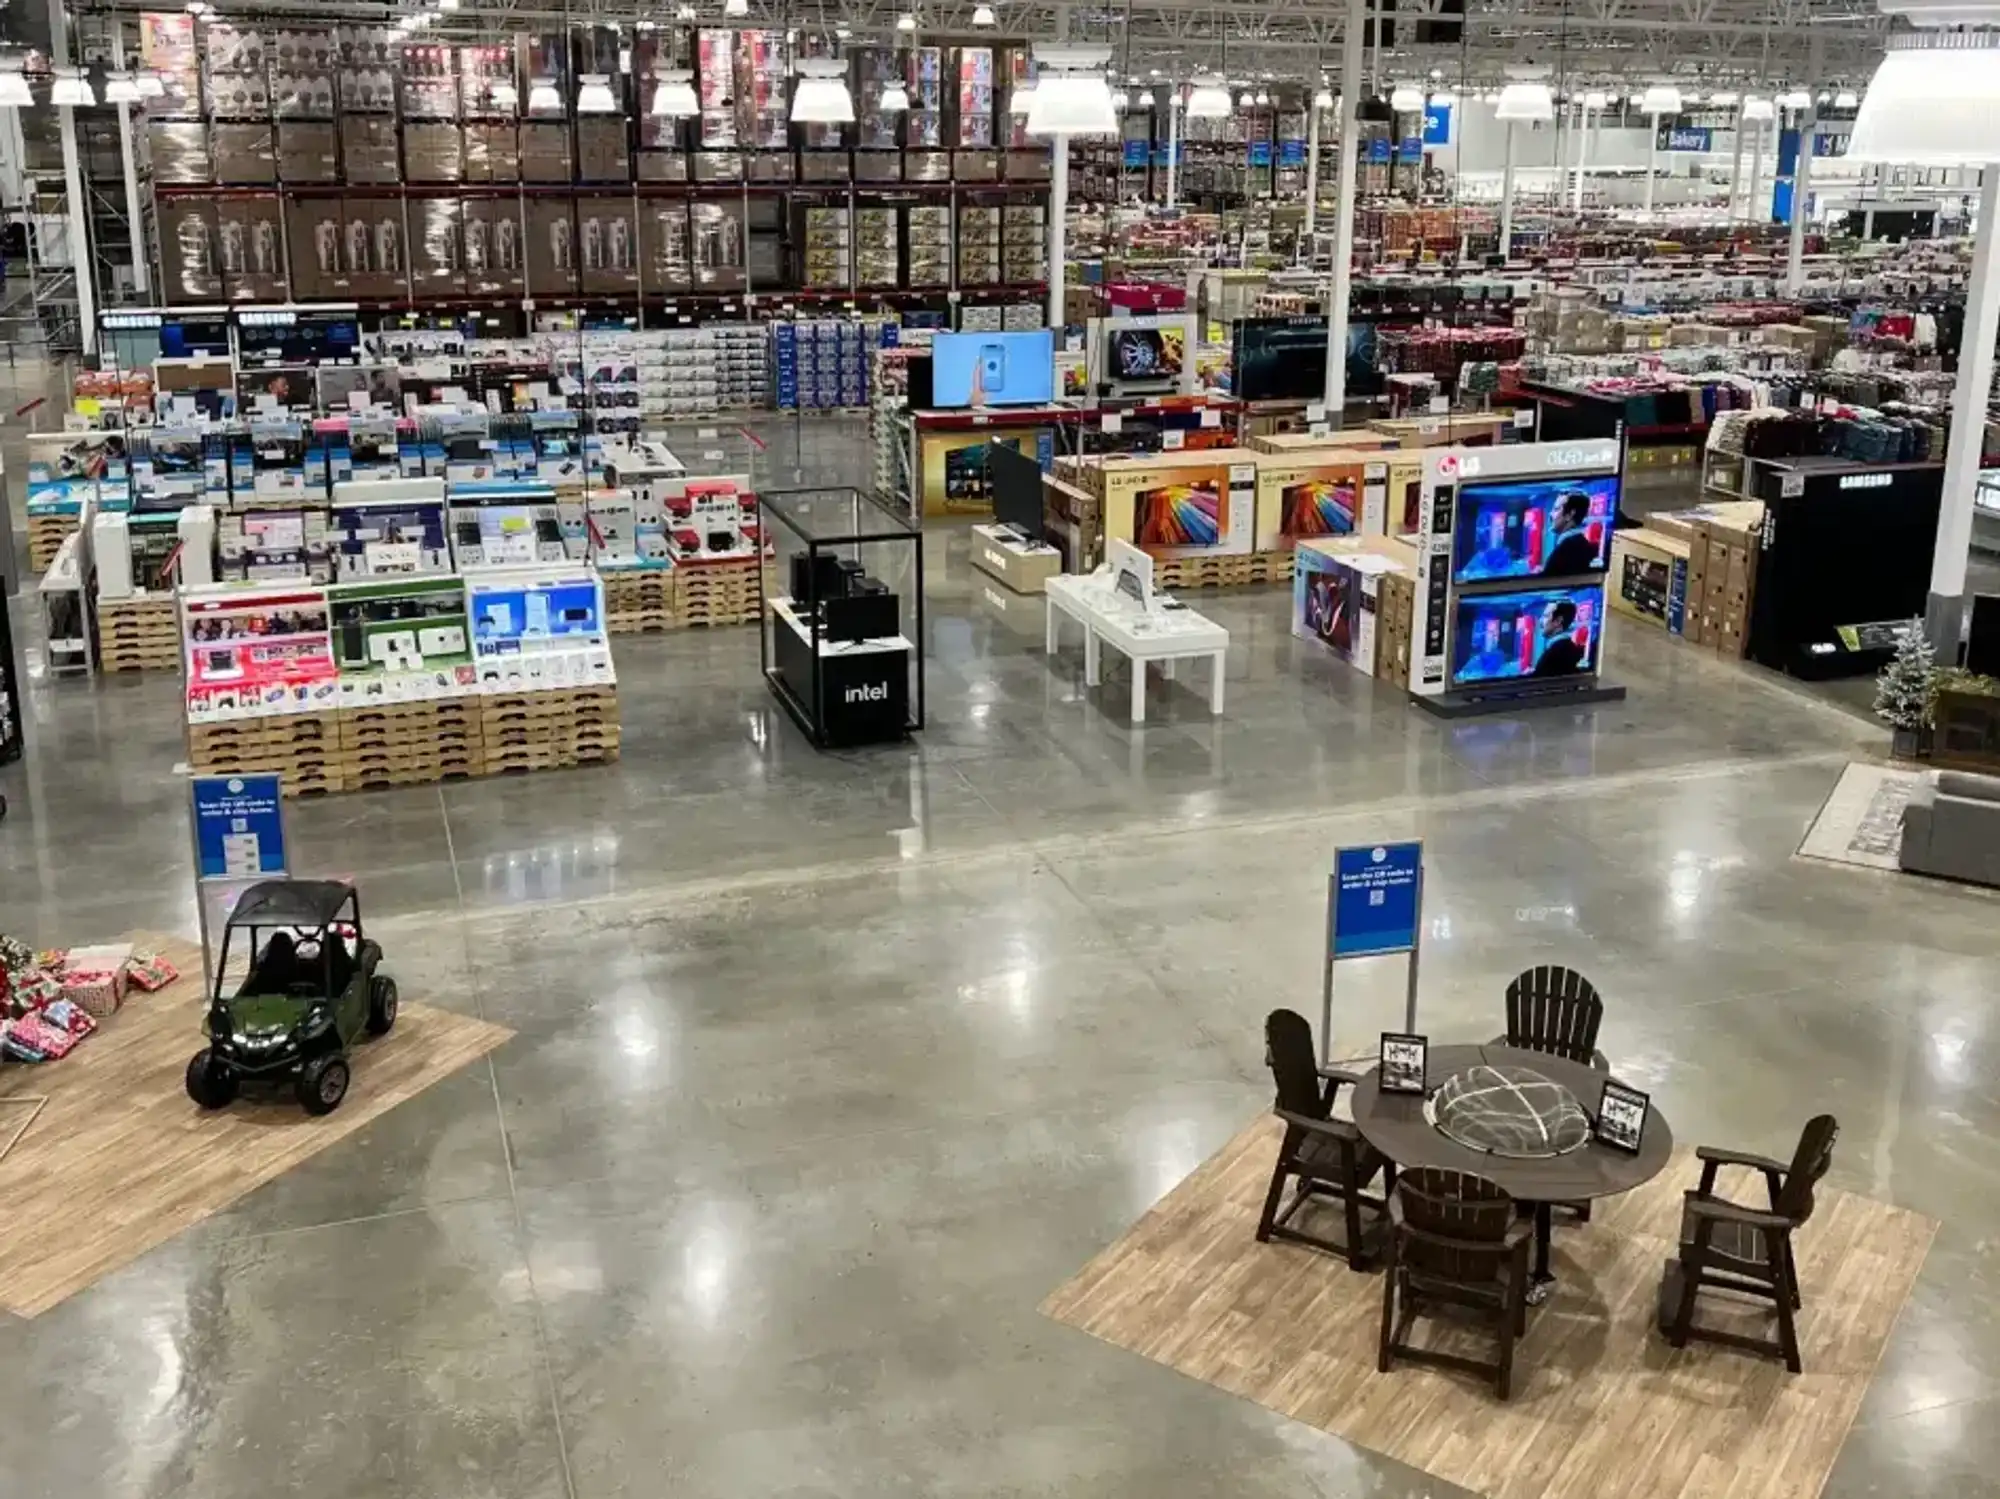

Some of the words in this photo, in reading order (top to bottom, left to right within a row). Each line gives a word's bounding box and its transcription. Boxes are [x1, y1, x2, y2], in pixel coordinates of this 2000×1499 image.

[1668, 130, 1707, 149] Bakery
[1459, 457, 1481, 475] LG
[1840, 473, 1893, 489] SAMSUNG
[845, 680, 888, 704] intel
